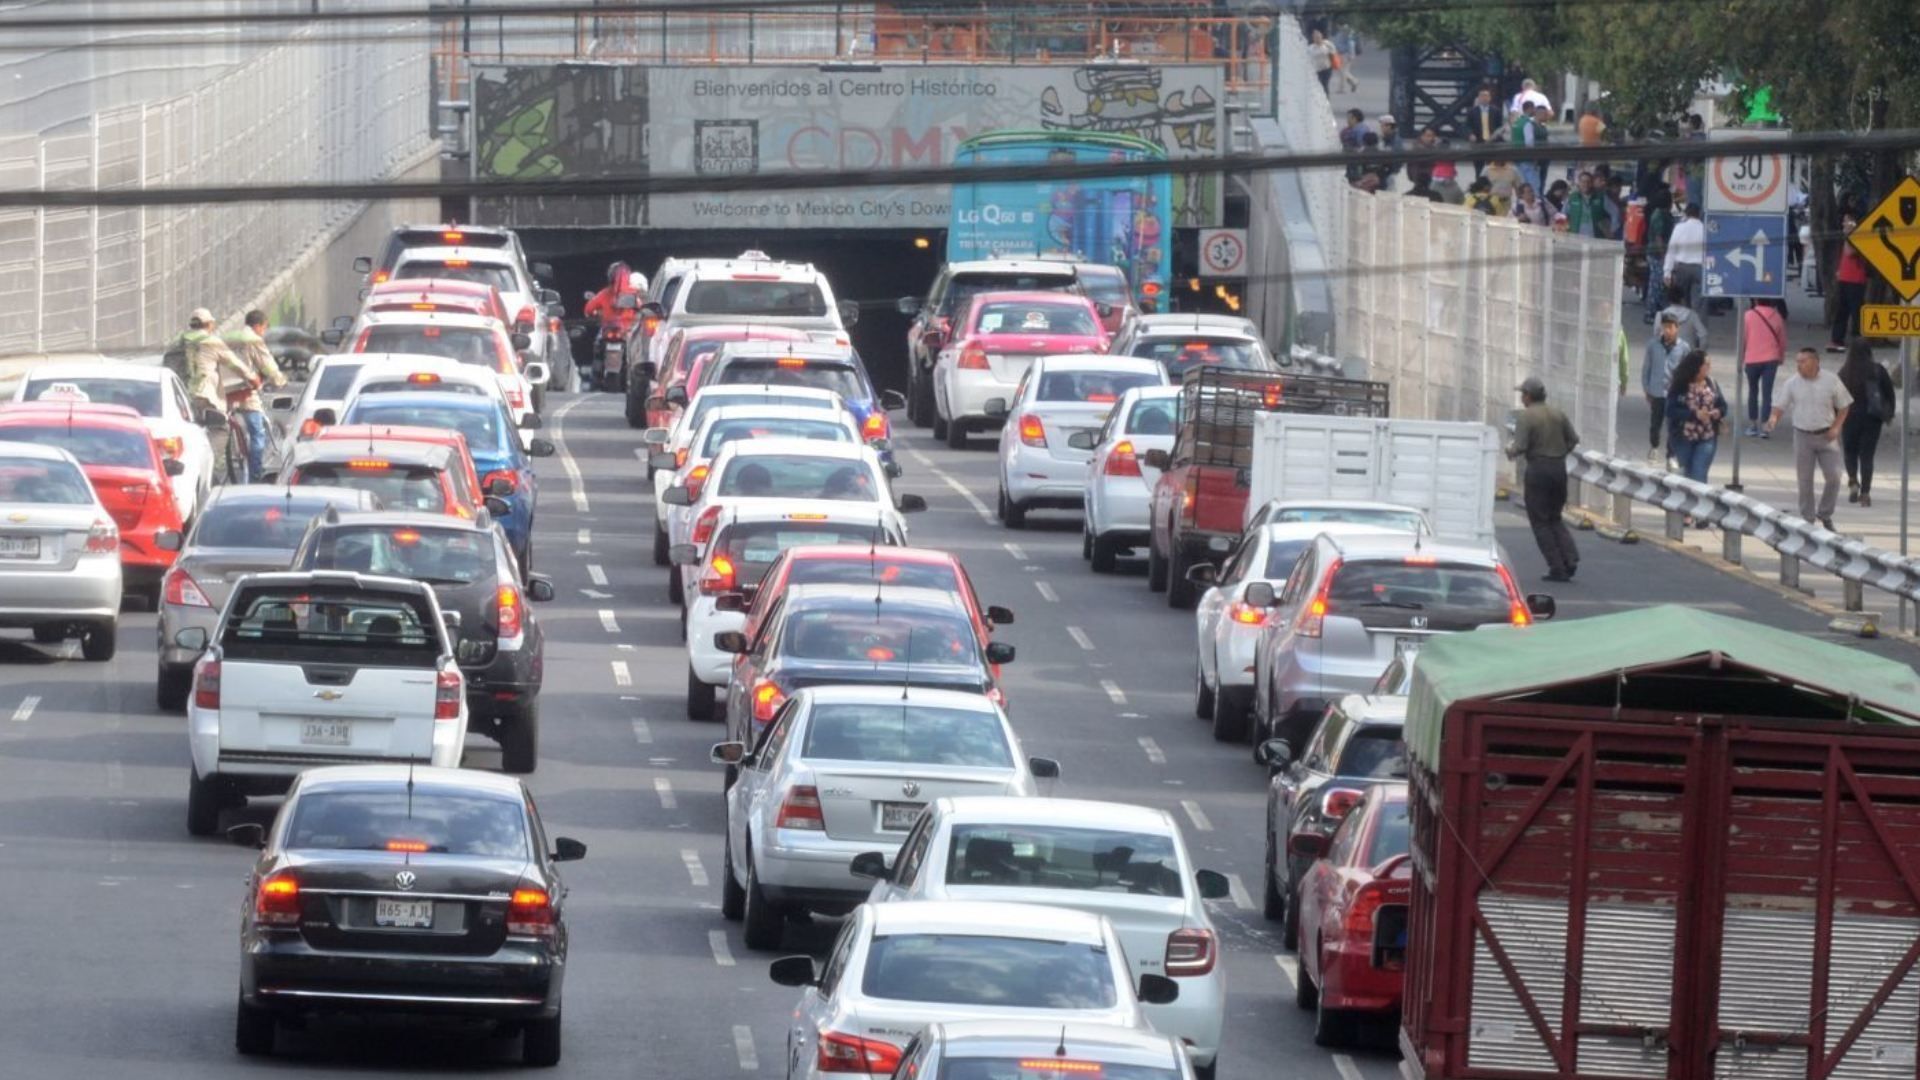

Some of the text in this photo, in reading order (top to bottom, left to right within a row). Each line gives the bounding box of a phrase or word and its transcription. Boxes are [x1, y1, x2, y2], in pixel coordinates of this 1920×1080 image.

[693, 77, 997, 97] Bienvenidos al Centro Histórico
[1733, 154, 1762, 180] 30
[693, 200, 952, 218] Welcome to Mexico City's Dow
[958, 209, 980, 225] LG
[1869, 311, 1920, 332] A 500
[54, 384, 75, 394] TAXI
